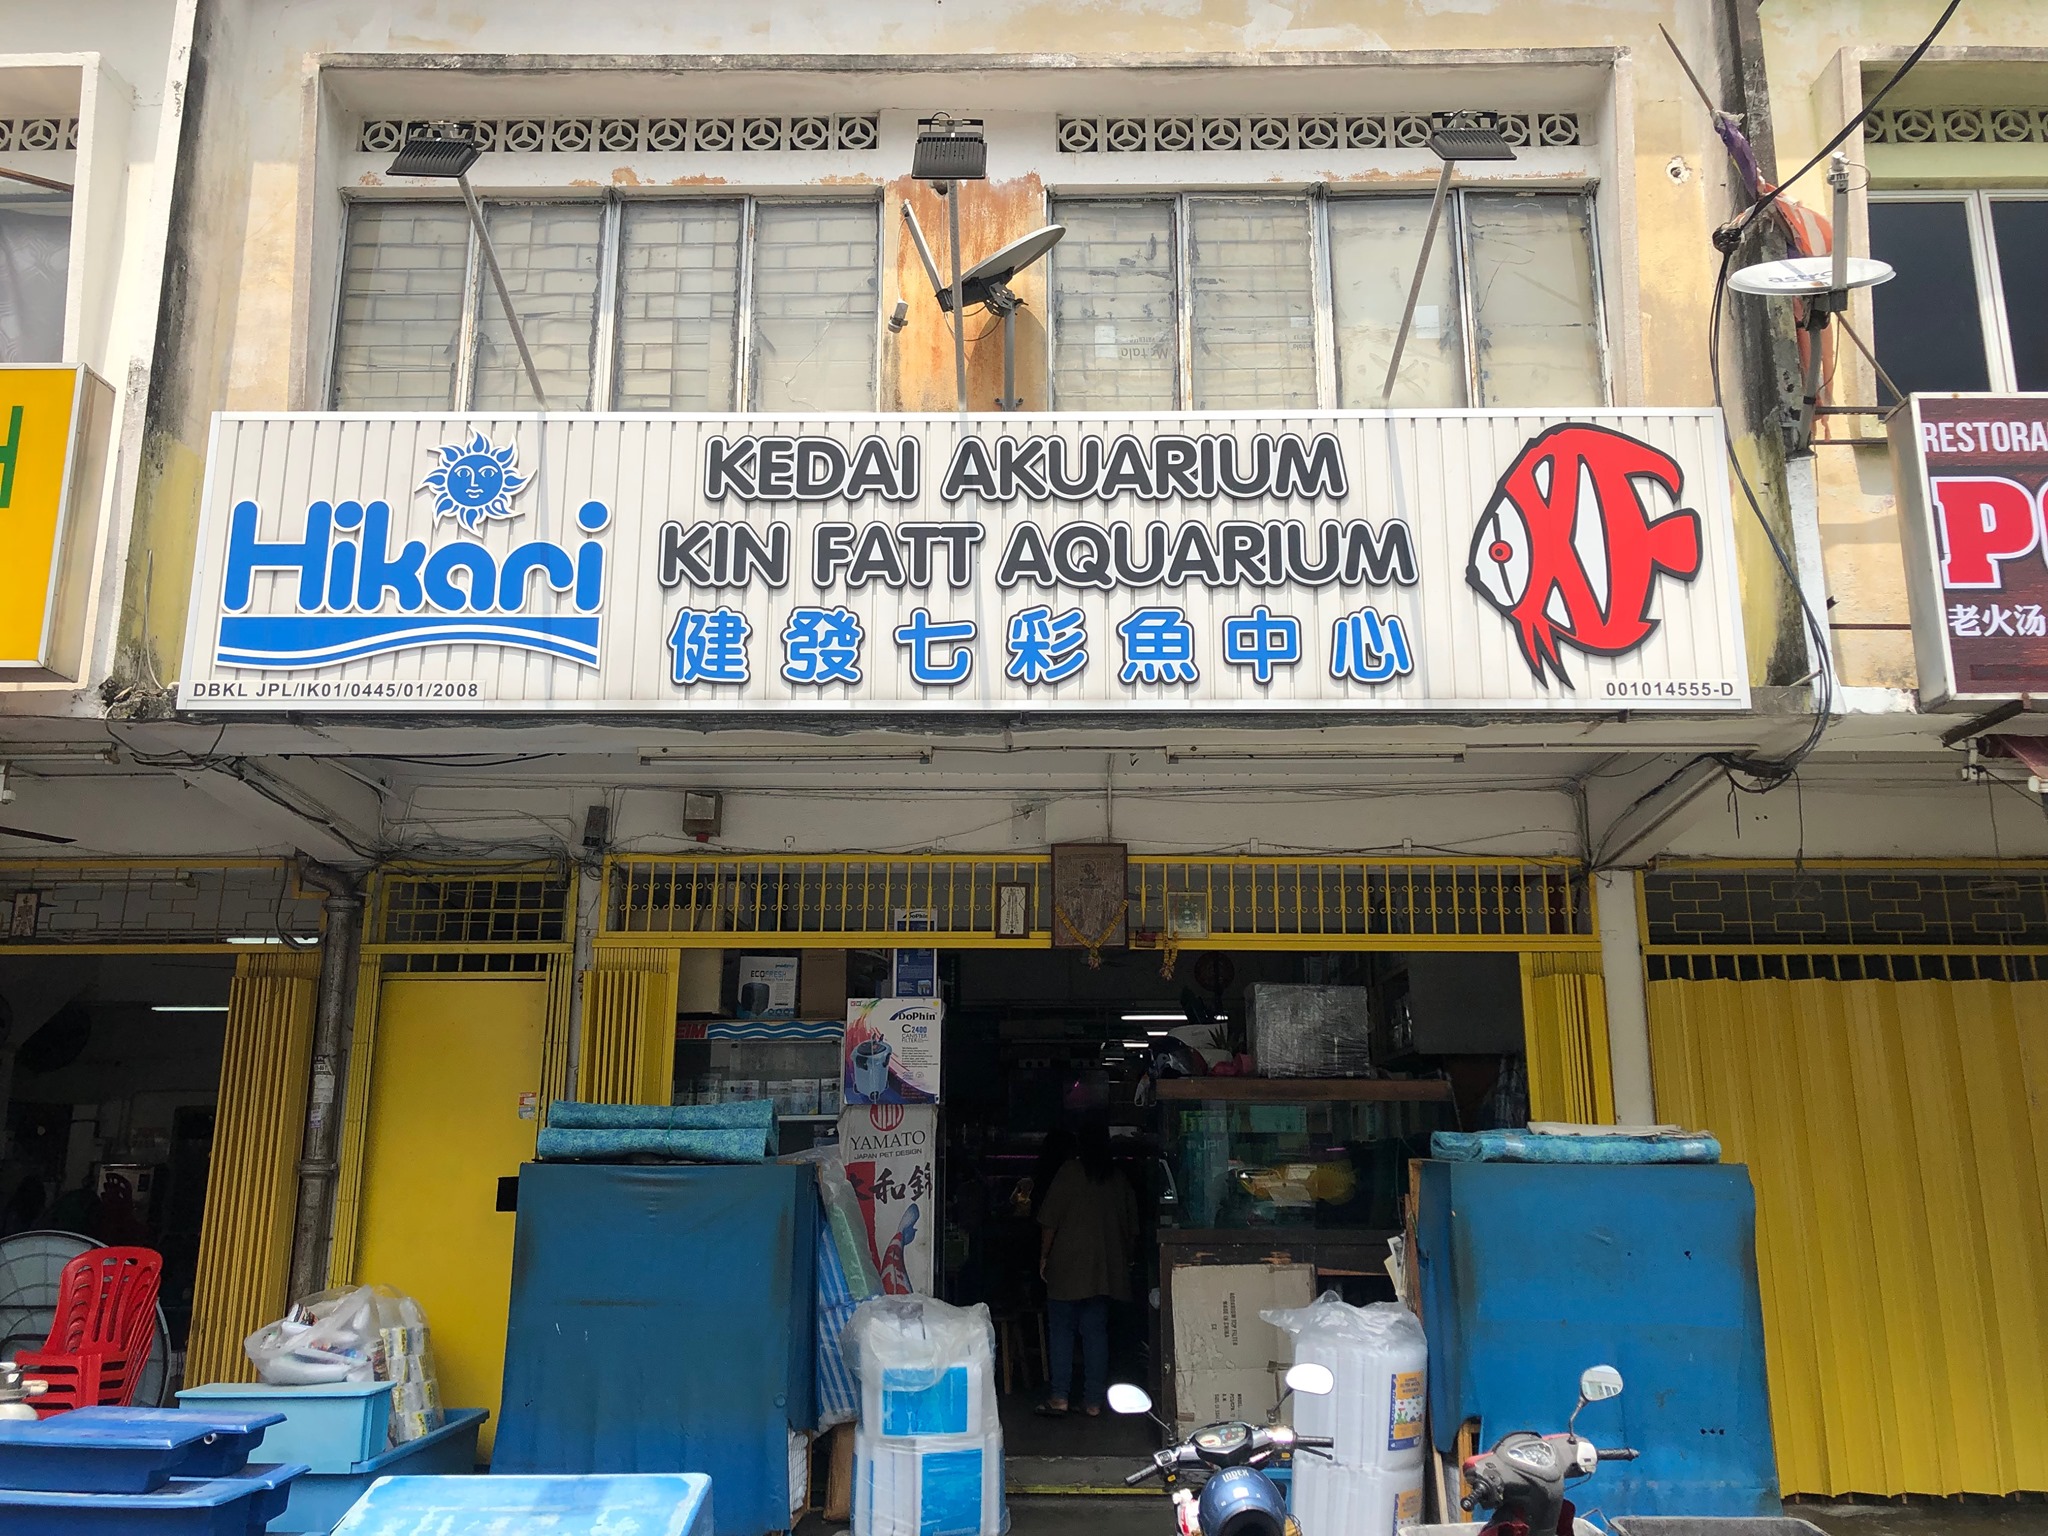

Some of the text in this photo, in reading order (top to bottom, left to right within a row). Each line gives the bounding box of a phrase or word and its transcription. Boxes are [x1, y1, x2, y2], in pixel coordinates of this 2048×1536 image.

[1922, 421, 2048, 453] RESTORA
[705, 434, 1348, 501] KEDAI AKUARIUM
[222, 499, 611, 613] Hikari
[659, 519, 1419, 590] KIN FATT AQUARIUM
[1948, 604, 2047, 637] 老火汤
[667, 605, 1414, 685] 健發七彩魚中心
[193, 683, 479, 698] DBKL JPL/IK01/0445/01/2008
[1606, 682, 1734, 697] 001014555-D
[850, 1130, 926, 1151] YAMATO
[895, 1149, 922, 1157] DESIGN
